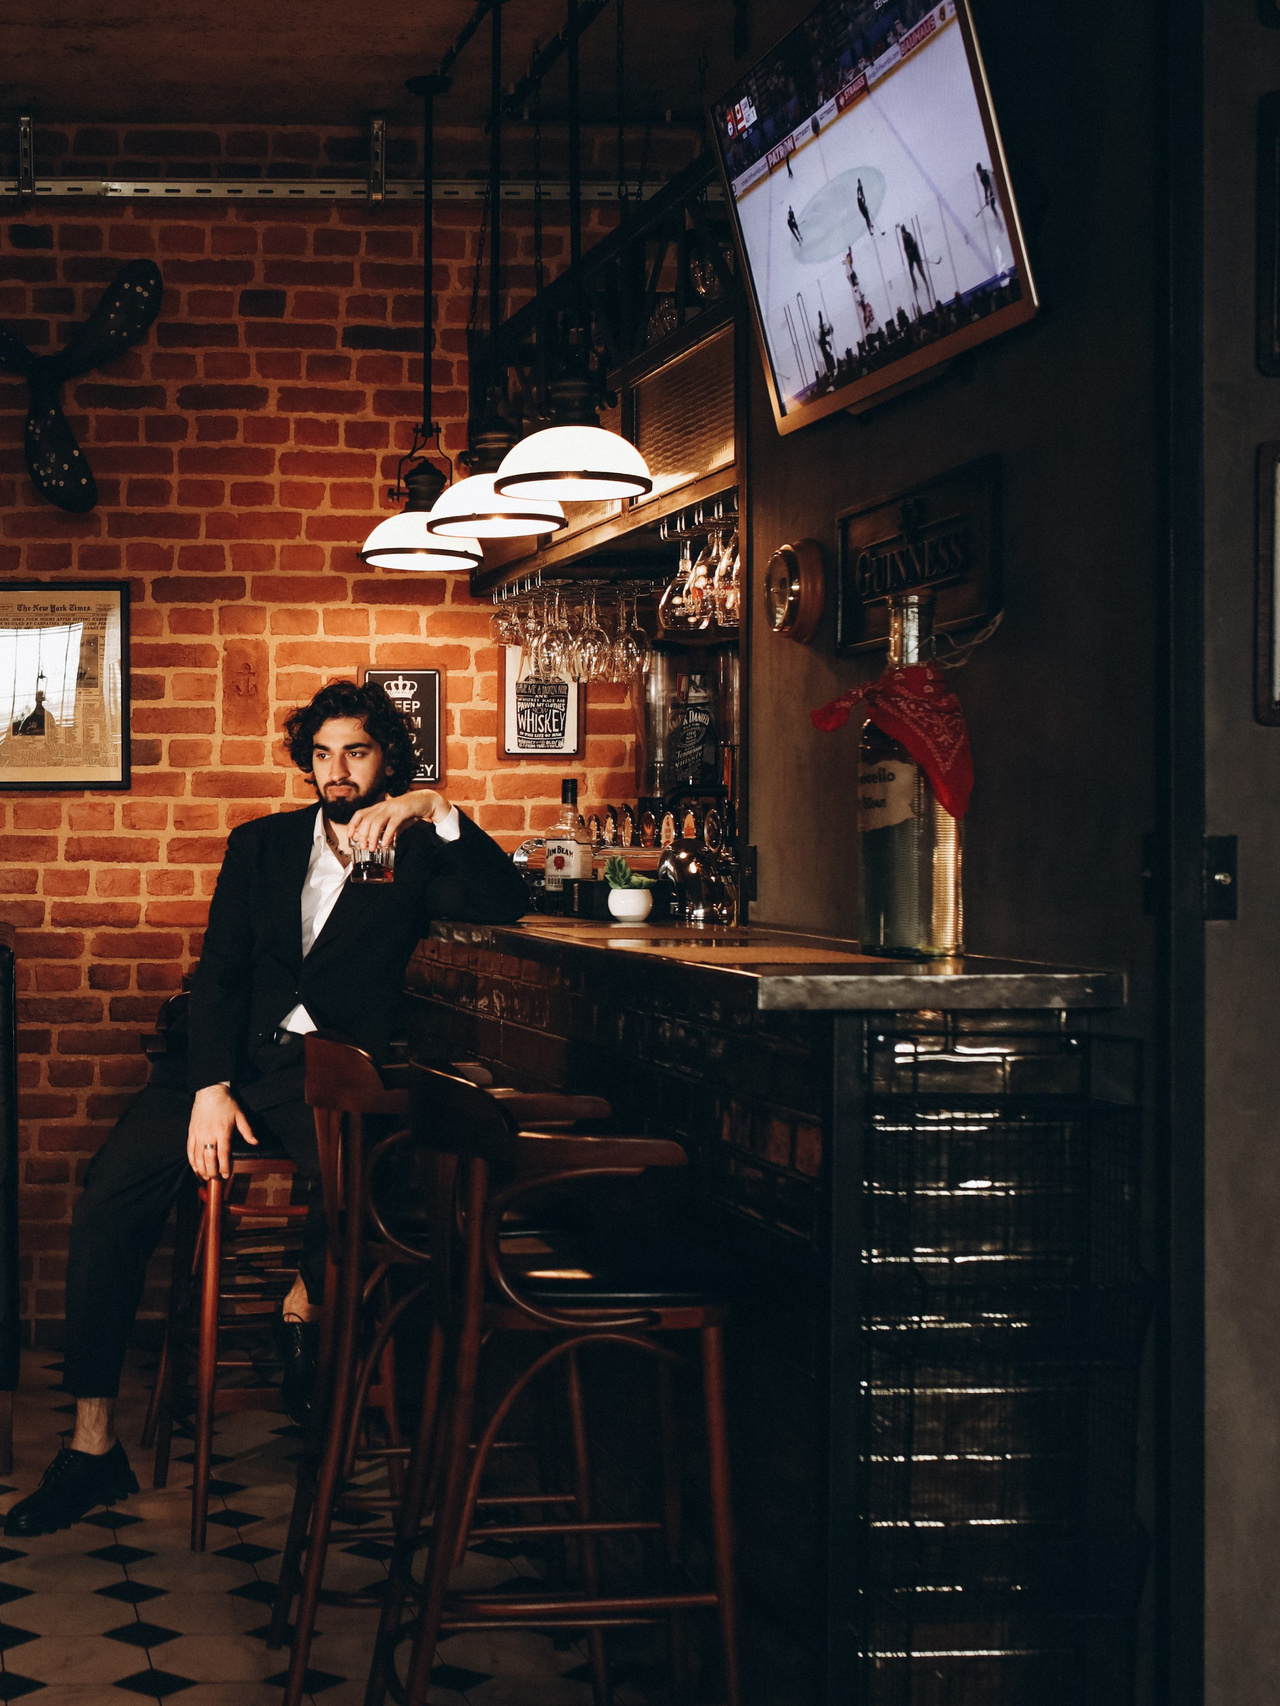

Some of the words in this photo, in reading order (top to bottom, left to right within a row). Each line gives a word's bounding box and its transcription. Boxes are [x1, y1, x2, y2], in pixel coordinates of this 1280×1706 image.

[900, 16, 936, 56] BAUHAUS
[844, 76, 865, 99] STRAUSS
[855, 534, 963, 597] GUINNESS
[17, 604, 31, 612] The
[33, 604, 48, 612] New
[50, 604, 67, 613] York
[394, 700, 421, 713] EEP
[518, 702, 535, 712] PAWN
[545, 702, 566, 712] CLOTHES
[518, 709, 566, 733] WHISKEY
[546, 848, 556, 859] JIM
[557, 845, 574, 858] BEAM
